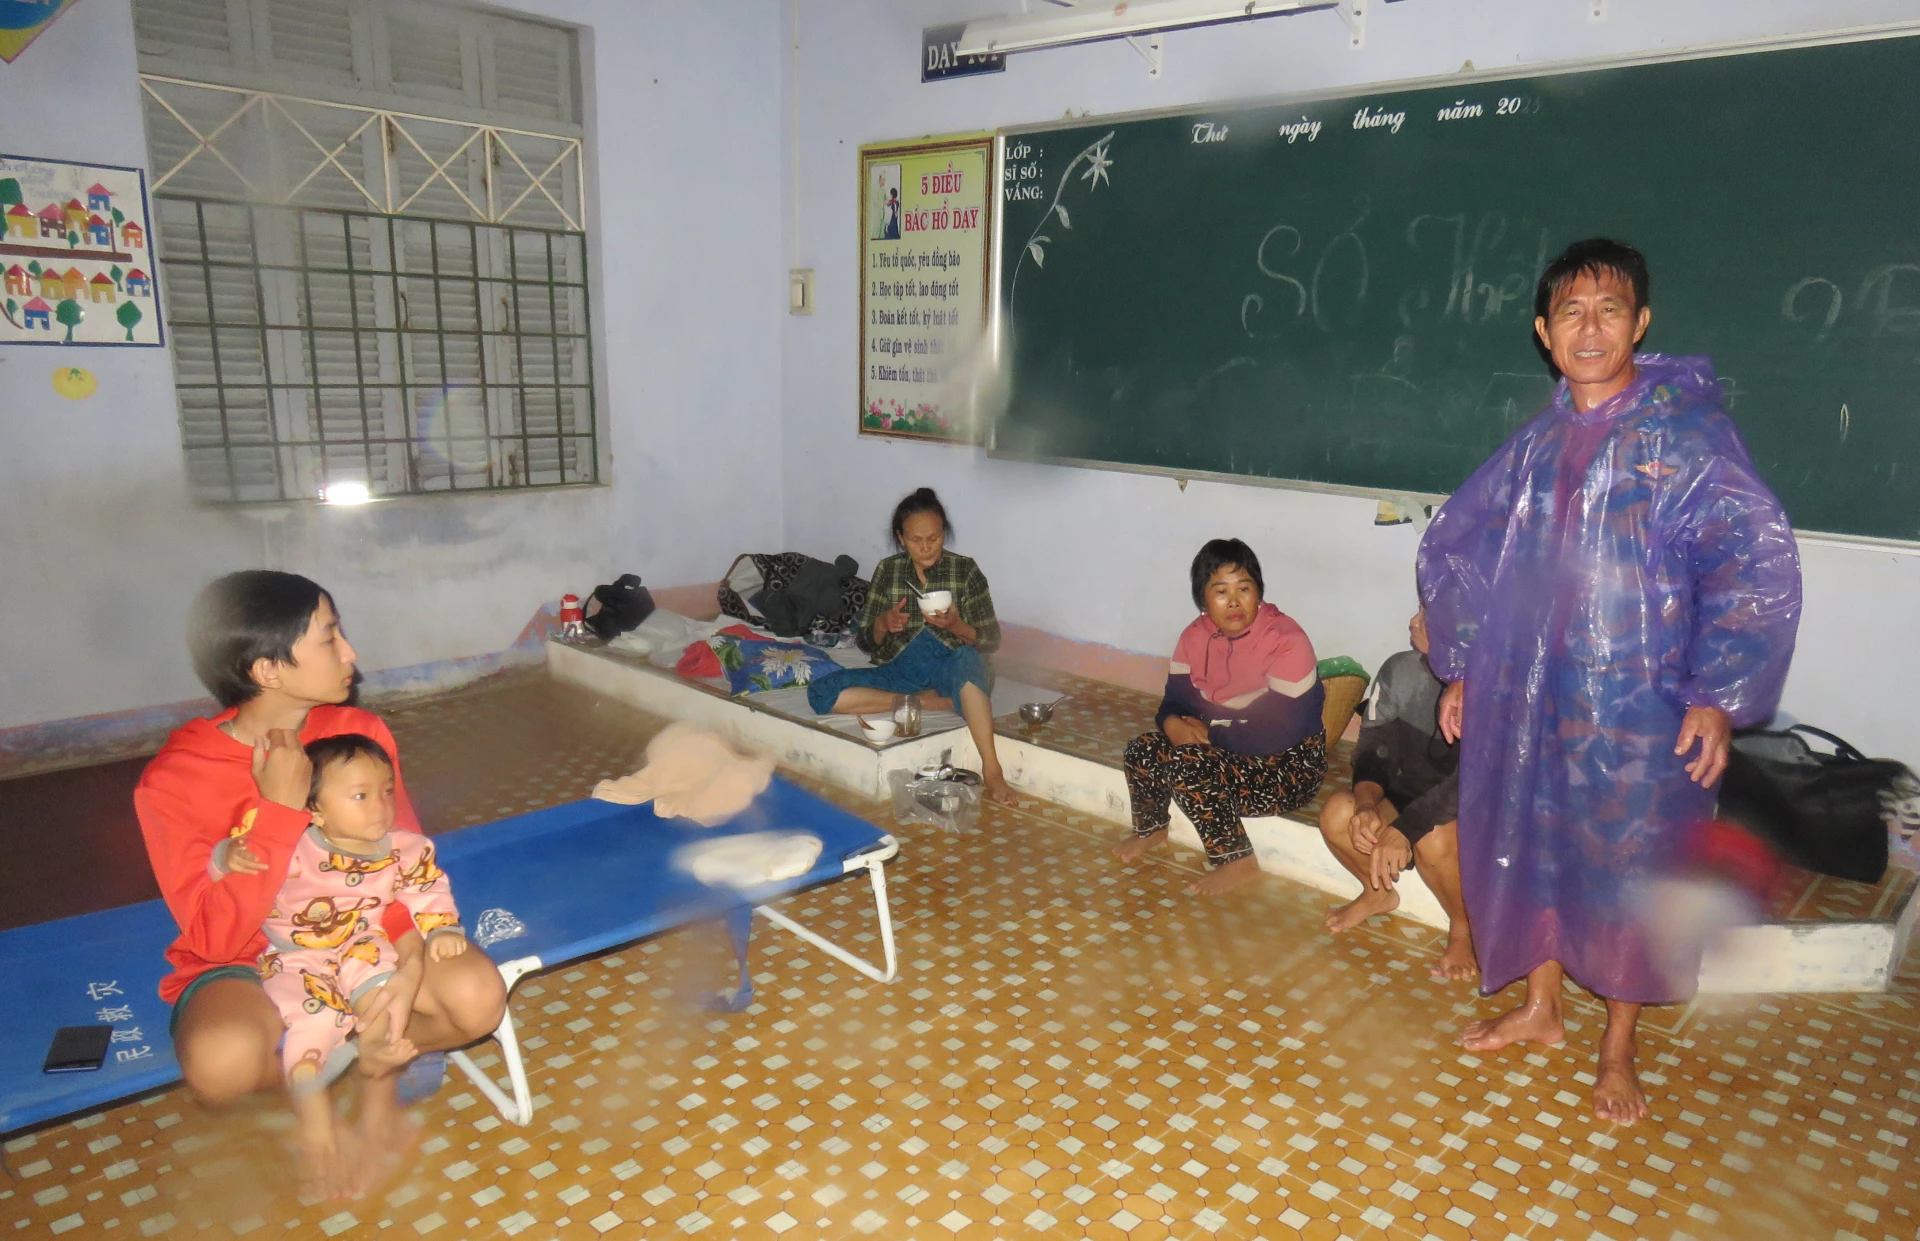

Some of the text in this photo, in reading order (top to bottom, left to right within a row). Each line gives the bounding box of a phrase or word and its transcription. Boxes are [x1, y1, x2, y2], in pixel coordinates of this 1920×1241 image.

[1279, 115, 1321, 143] ngày
[1351, 107, 1406, 135] tháng
[1436, 99, 1483, 121] năm
[921, 162, 962, 196] 5 ĐIỀU
[1004, 164, 1017, 182] SĨ
[904, 199, 979, 234] BÁC HỒ DẠY
[879, 252, 890, 268] Yêu
[900, 248, 917, 272] quốc,
[918, 251, 930, 272] yêu
[931, 246, 947, 272] đồng
[871, 276, 959, 301] 2. Học tập tốt, lao động tốt
[871, 309, 877, 325] 3.
[879, 308, 895, 325] Đoàn
[896, 306, 907, 325] kết
[871, 337, 877, 353] 4.
[879, 337, 891, 353] Giữ
[892, 337, 902, 358] gìn
[914, 338, 928, 355] sinh
[871, 365, 877, 380] 5.
[878, 364, 897, 381] Khiêm
